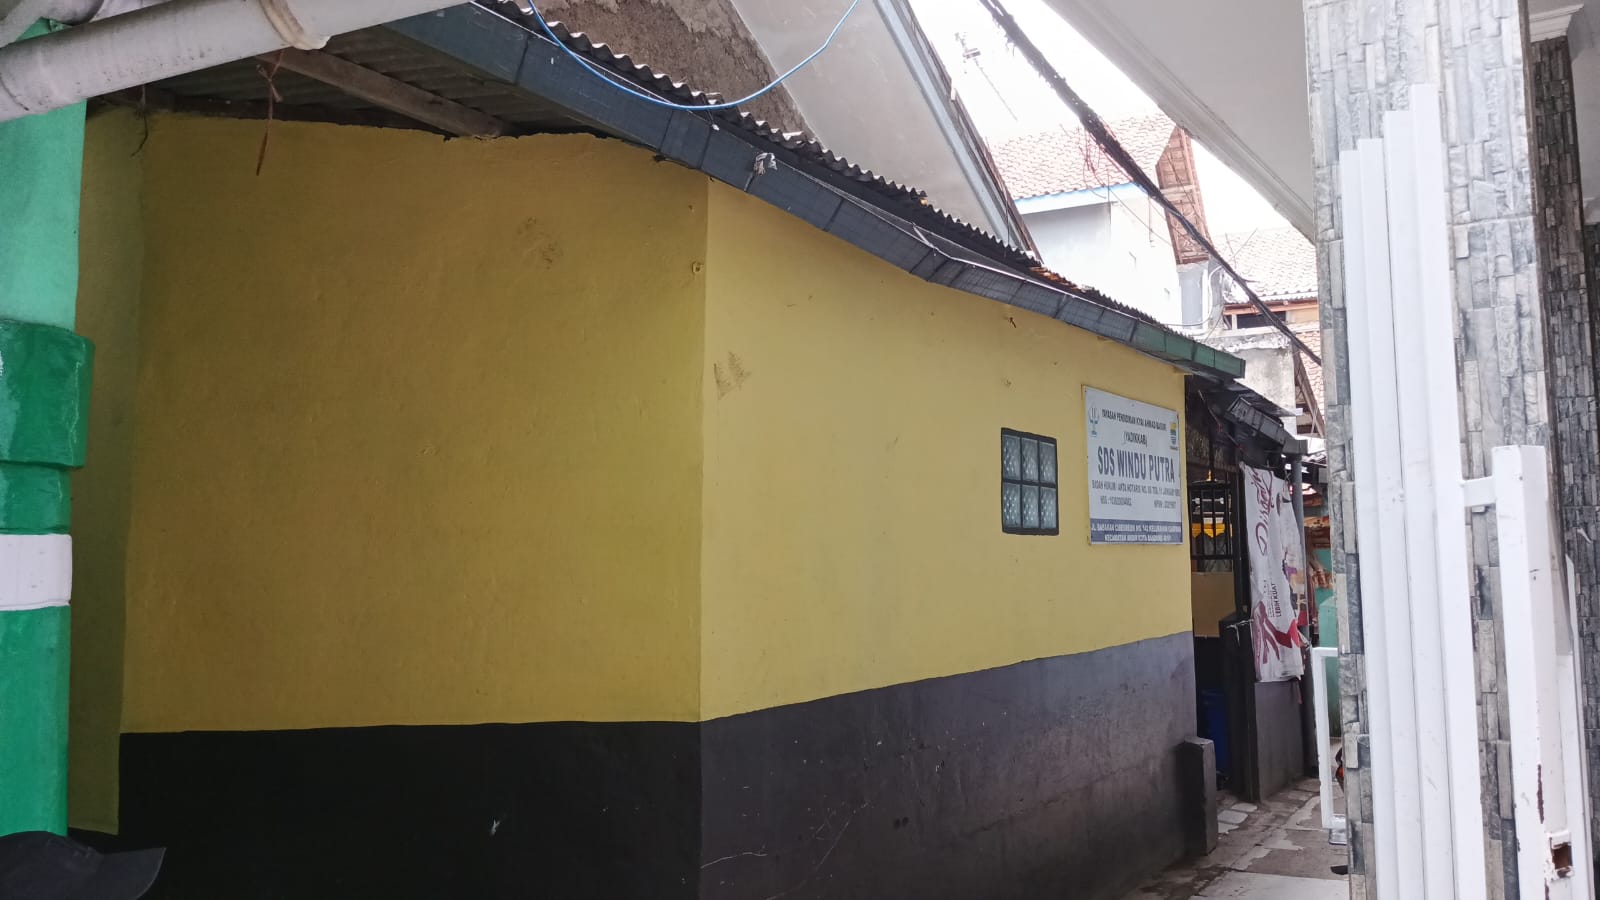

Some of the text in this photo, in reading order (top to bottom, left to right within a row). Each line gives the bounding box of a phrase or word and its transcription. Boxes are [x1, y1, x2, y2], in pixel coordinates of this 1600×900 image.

[1102, 409, 1116, 421] YAYASAN
[1098, 446, 1175, 483] SDS WINDU PUTRA
[1274, 600, 1282, 618] LEBIH
